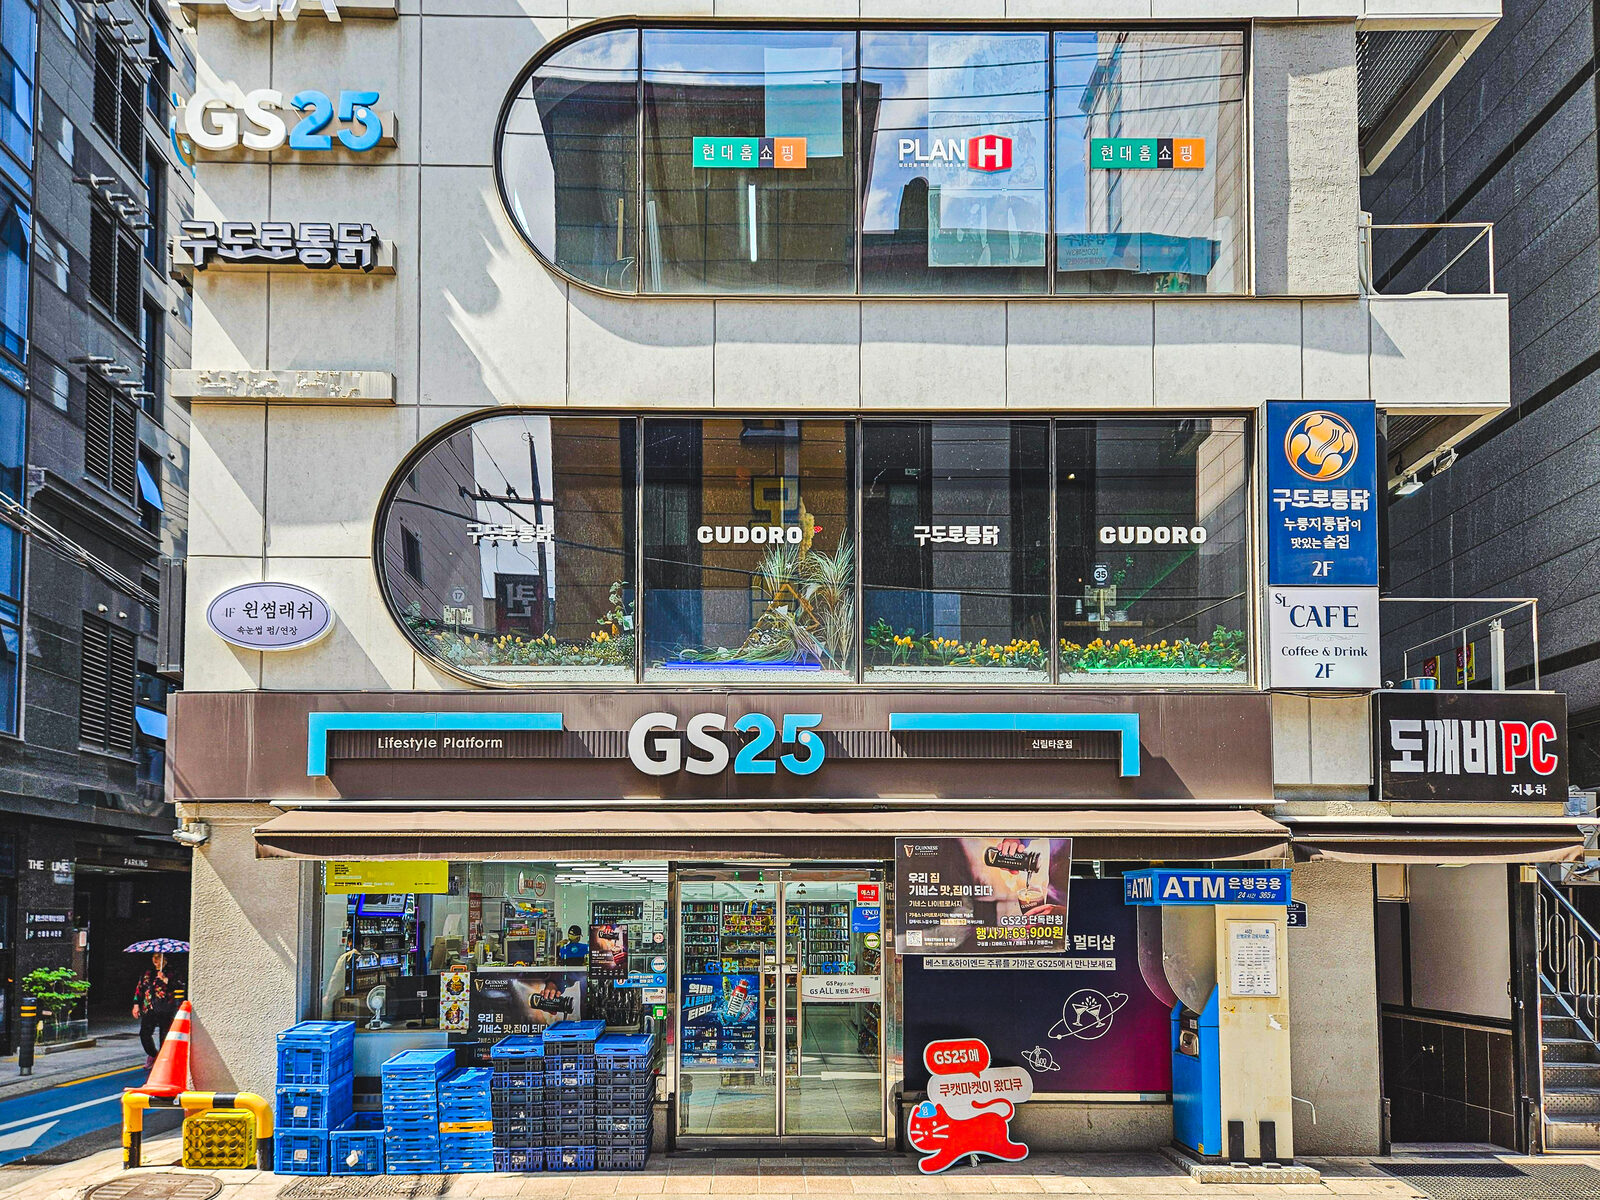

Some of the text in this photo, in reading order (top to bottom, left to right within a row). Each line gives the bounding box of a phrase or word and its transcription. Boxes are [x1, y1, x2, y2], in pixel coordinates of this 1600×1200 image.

[185, 89, 382, 151] GS25
[702, 143, 794, 163] 현대홈쇼핑
[898, 138, 965, 161] PLAN
[1100, 143, 1193, 163] 현대홈쇼핑
[180, 220, 378, 273] 구도로통닭
[1273, 489, 1370, 512] 구도로통닭
[466, 523, 554, 545] 구도로통닭
[697, 526, 803, 544] GUDORO
[913, 525, 1000, 547] 구도로통닭
[1099, 526, 1207, 544] GUDORO
[1095, 571, 1106, 579] 35
[1312, 560, 1335, 577] 2F
[454, 592, 463, 600] 17
[242, 600, 313, 620] 윈썸래쉬
[1290, 605, 1359, 628] CAFE
[237, 625, 298, 636] 속눈썹 펌/연장
[1281, 646, 1368, 657] Coffee & Drink
[1315, 663, 1336, 679] 2F
[377, 736, 503, 751] Lifestyle Platform
[627, 712, 826, 776] GS25
[1031, 739, 1073, 749] 신림타운점
[28, 859, 70, 872] THE LINE
[123, 858, 148, 868] PARKING
[908, 872, 940, 884] 우리 집
[908, 885, 994, 897] 기네스 맛,집이 되다
[1131, 877, 1152, 899] ATM
[1162, 877, 1282, 899] ATM 은행공용
[1000, 915, 1063, 925] GS25 단독런칭
[1073, 934, 1116, 951] 멀티샵
[705, 961, 739, 973] GS25
[822, 961, 856, 973] GS25
[925, 959, 1114, 968] 베스트&하이엔드 주류를 가까운 GS25에서 만나보세요
[477, 1013, 504, 1023] 우리 집
[477, 1024, 502, 1034] 기네스
[939, 1078, 1023, 1097] 쿠캣마켓이 왔다쿠
